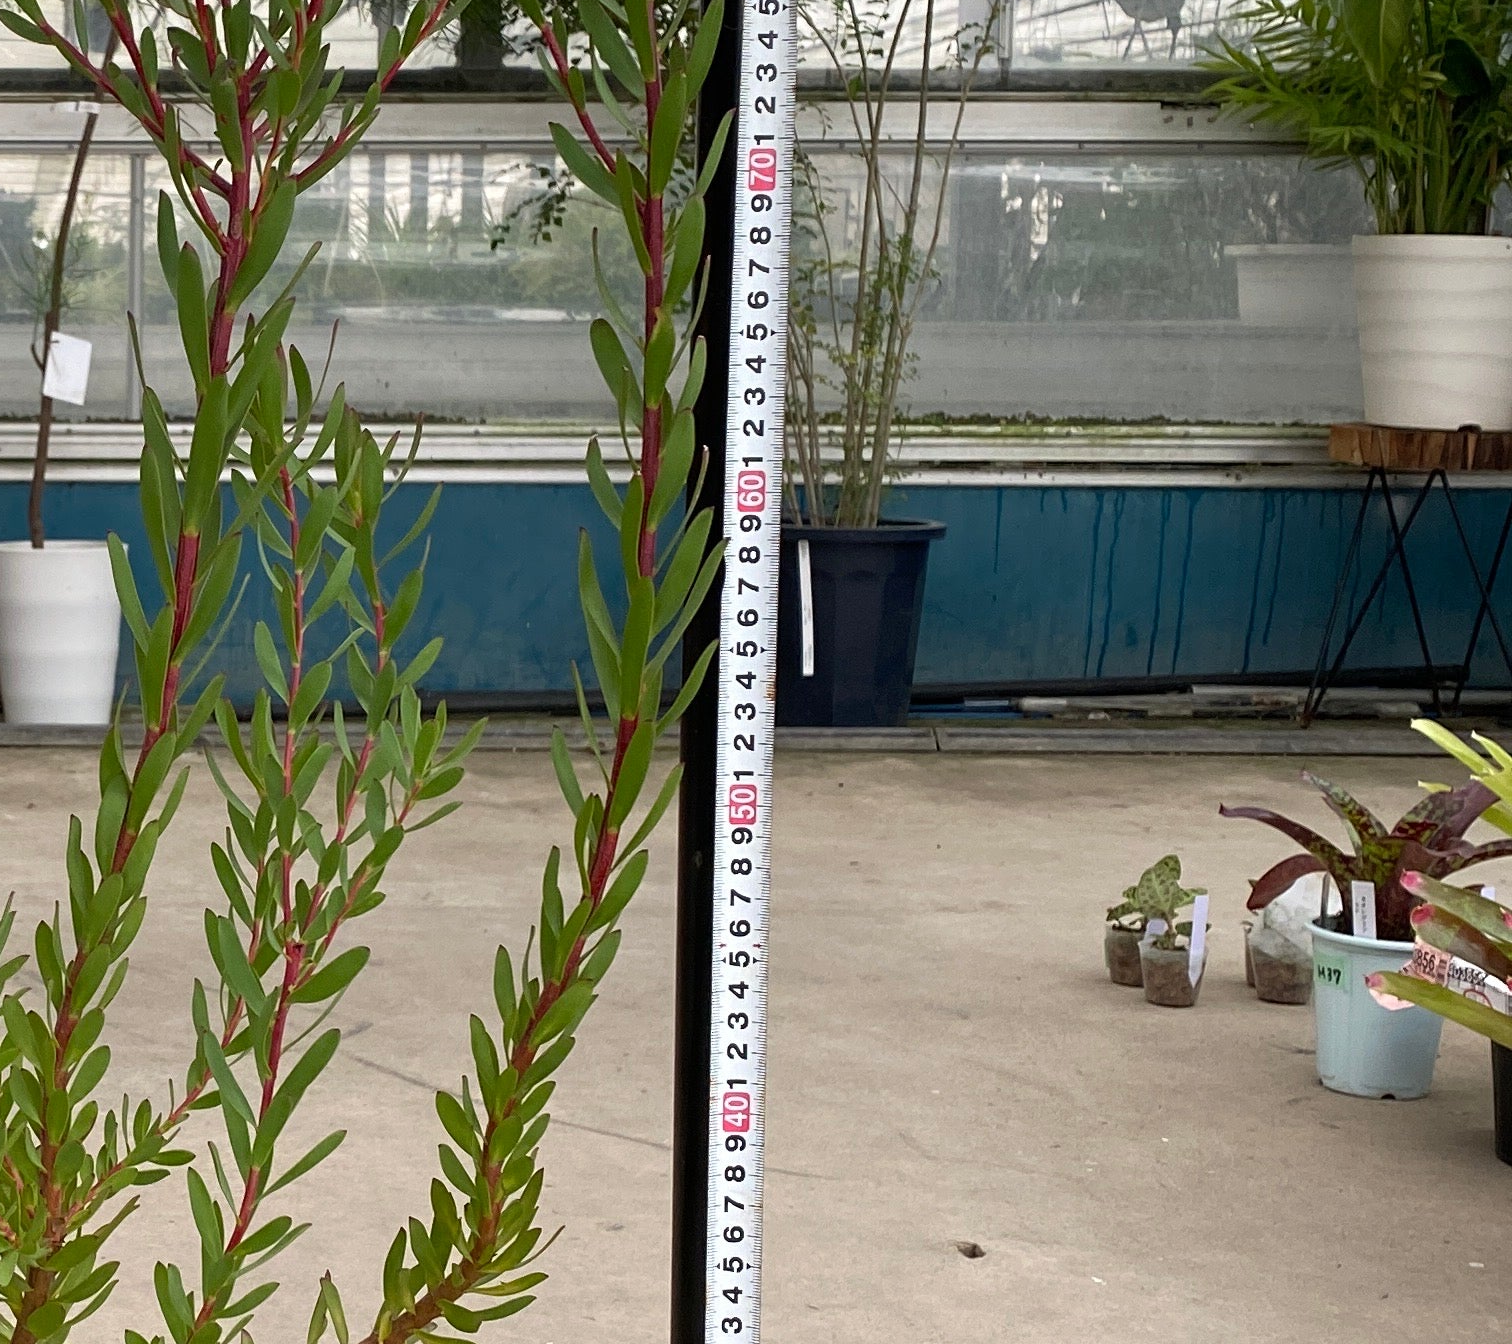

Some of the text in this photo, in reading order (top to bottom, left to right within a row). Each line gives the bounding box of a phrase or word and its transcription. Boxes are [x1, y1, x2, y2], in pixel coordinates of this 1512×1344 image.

[757, 30, 779, 50] 4
[756, 63, 778, 83] 3
[754, 96, 776, 114] 2
[753, 134, 775, 146] 1
[750, 153, 774, 186] 70
[750, 193, 773, 213] 9
[749, 226, 772, 245] 8
[748, 258, 770, 277] 7
[747, 290, 769, 310] 6
[746, 323, 768, 341] 5
[745, 354, 767, 374] 4
[743, 387, 766, 406] 3
[742, 419, 765, 437] 2
[742, 456, 764, 468] 1
[739, 474, 764, 506] 60
[739, 514, 762, 533] 9
[738, 545, 761, 564] 8
[737, 577, 760, 595] 7
[736, 608, 759, 627] 6
[736, 640, 758, 658] 5
[735, 671, 757, 690] 4
[734, 702, 757, 721] 3
[733, 734, 755, 752] 2
[733, 770, 754, 781] 1
[730, 788, 755, 820] 50
[731, 827, 753, 845] 9
[730, 857, 753, 876] 8
[729, 888, 751, 907] 7
[729, 919, 751, 938] 6
[728, 950, 751, 968] 5
[728, 981, 749, 1000] 4
[727, 1012, 749, 1030] 3
[726, 1042, 748, 1060] 2
[726, 1079, 747, 1090] 1
[724, 1096, 749, 1127] 40
[724, 1134, 747, 1152] 9
[724, 1164, 746, 1183] 8
[724, 1195, 745, 1213] 7
[723, 1225, 745, 1243] 6
[722, 1256, 744, 1273] 5
[722, 1286, 743, 1304] 4
[721, 1316, 743, 1334] 3
